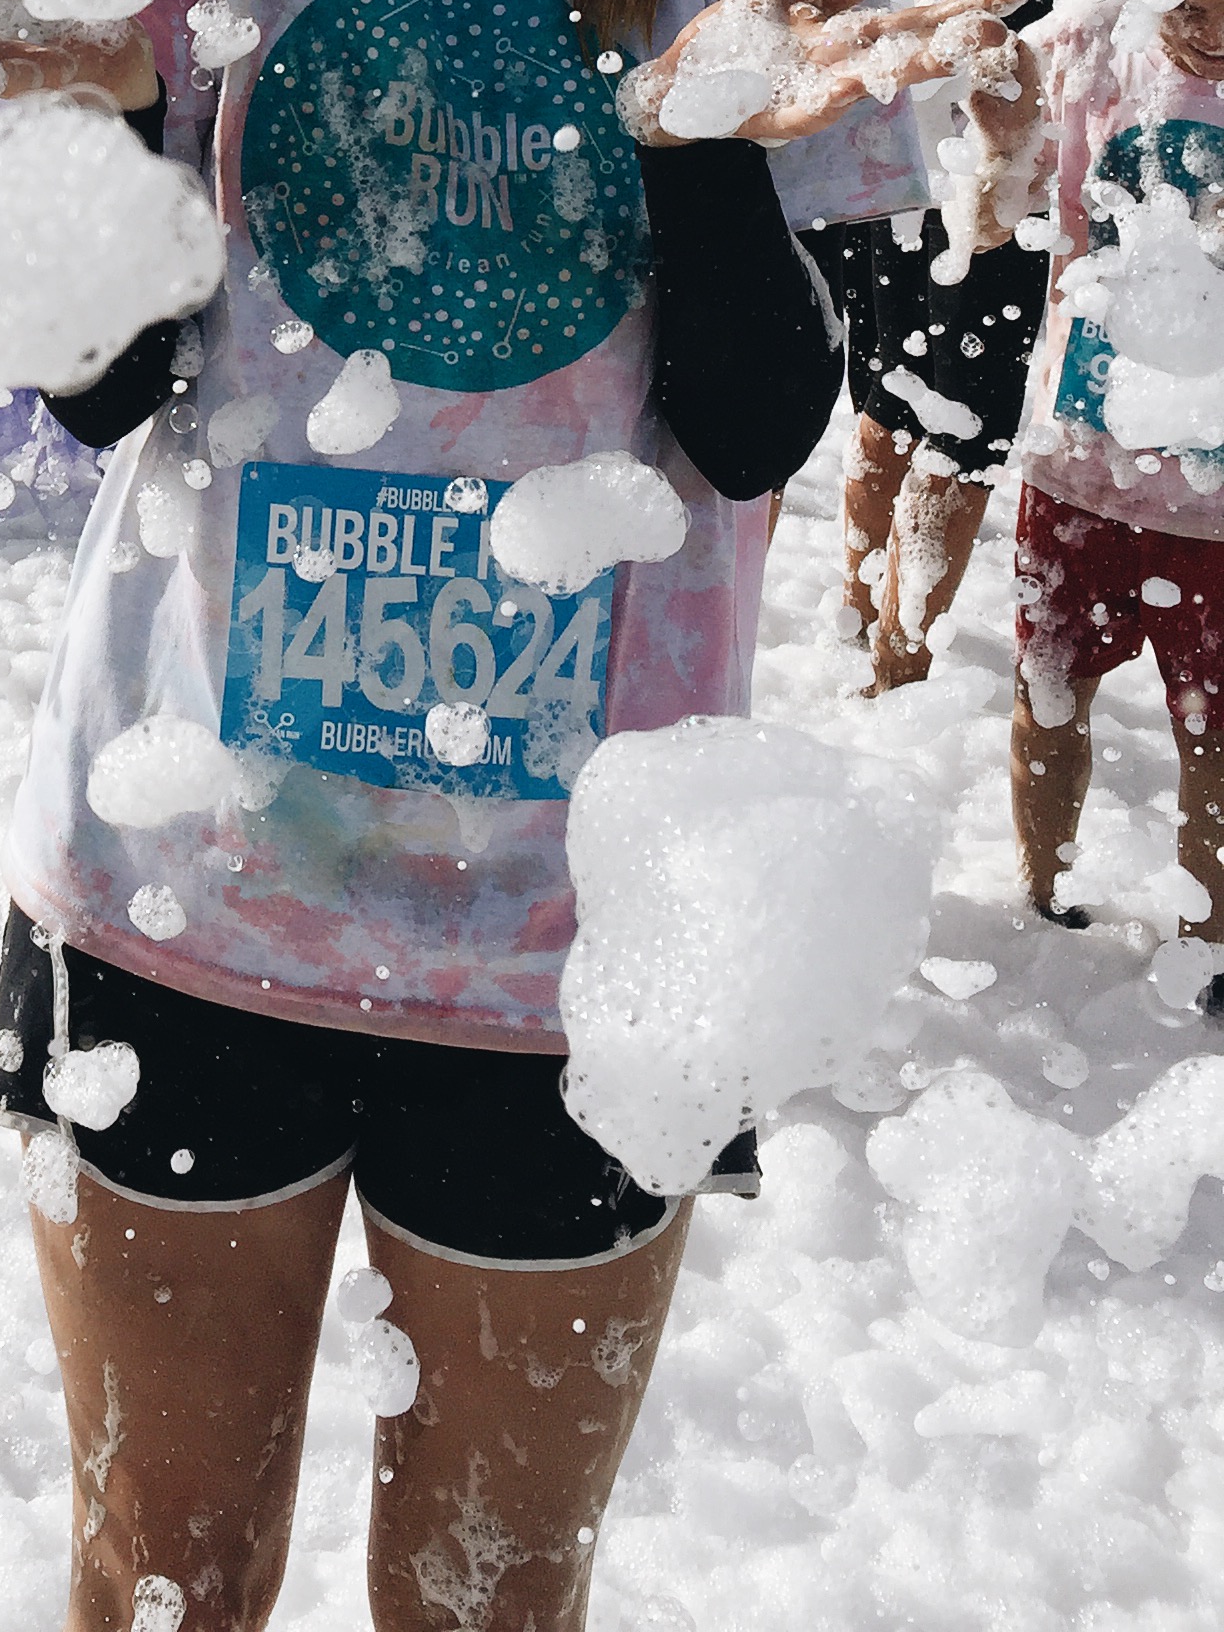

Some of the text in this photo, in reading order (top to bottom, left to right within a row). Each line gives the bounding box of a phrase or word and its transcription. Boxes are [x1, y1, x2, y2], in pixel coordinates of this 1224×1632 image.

[384, 80, 552, 179] Bubble
[410, 153, 514, 232] RUN
[428, 213, 553, 274] clean run
[376, 486, 489, 517] #BUBBLEN
[265, 502, 460, 579] BUBBLE
[237, 566, 601, 722] 145624
[320, 720, 512, 766] BUBBLEROM
